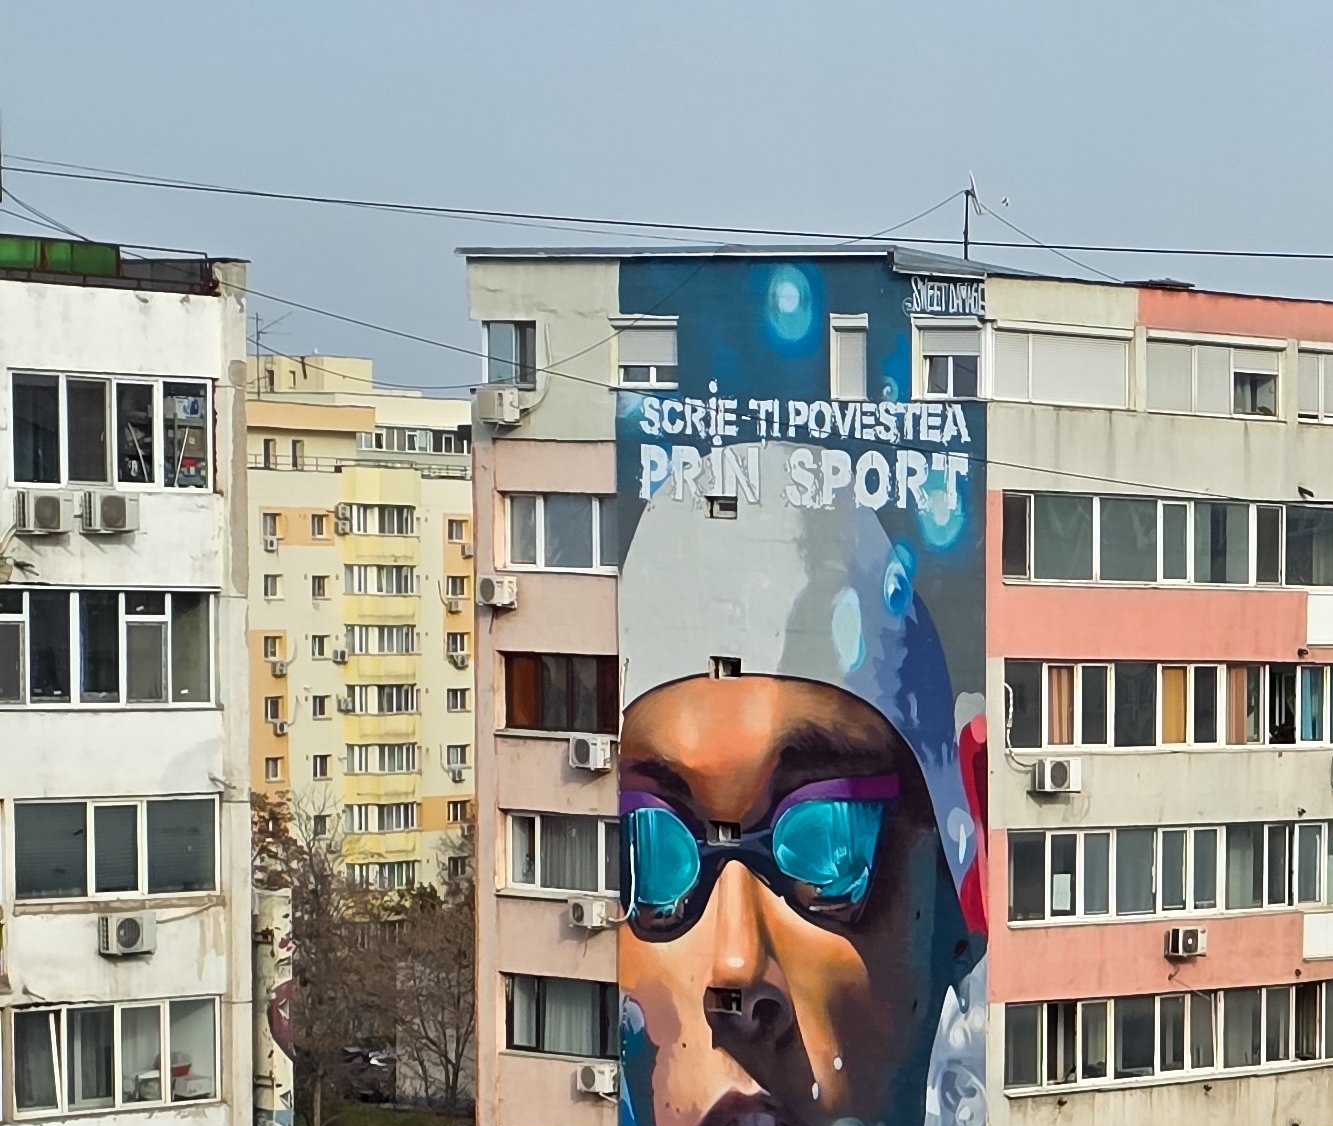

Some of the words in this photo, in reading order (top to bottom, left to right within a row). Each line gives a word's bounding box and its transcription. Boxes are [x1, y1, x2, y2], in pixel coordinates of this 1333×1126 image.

[787, 400, 972, 446] POVESTEA
[639, 435, 760, 503] PRIN
[785, 448, 969, 511] SPORT
